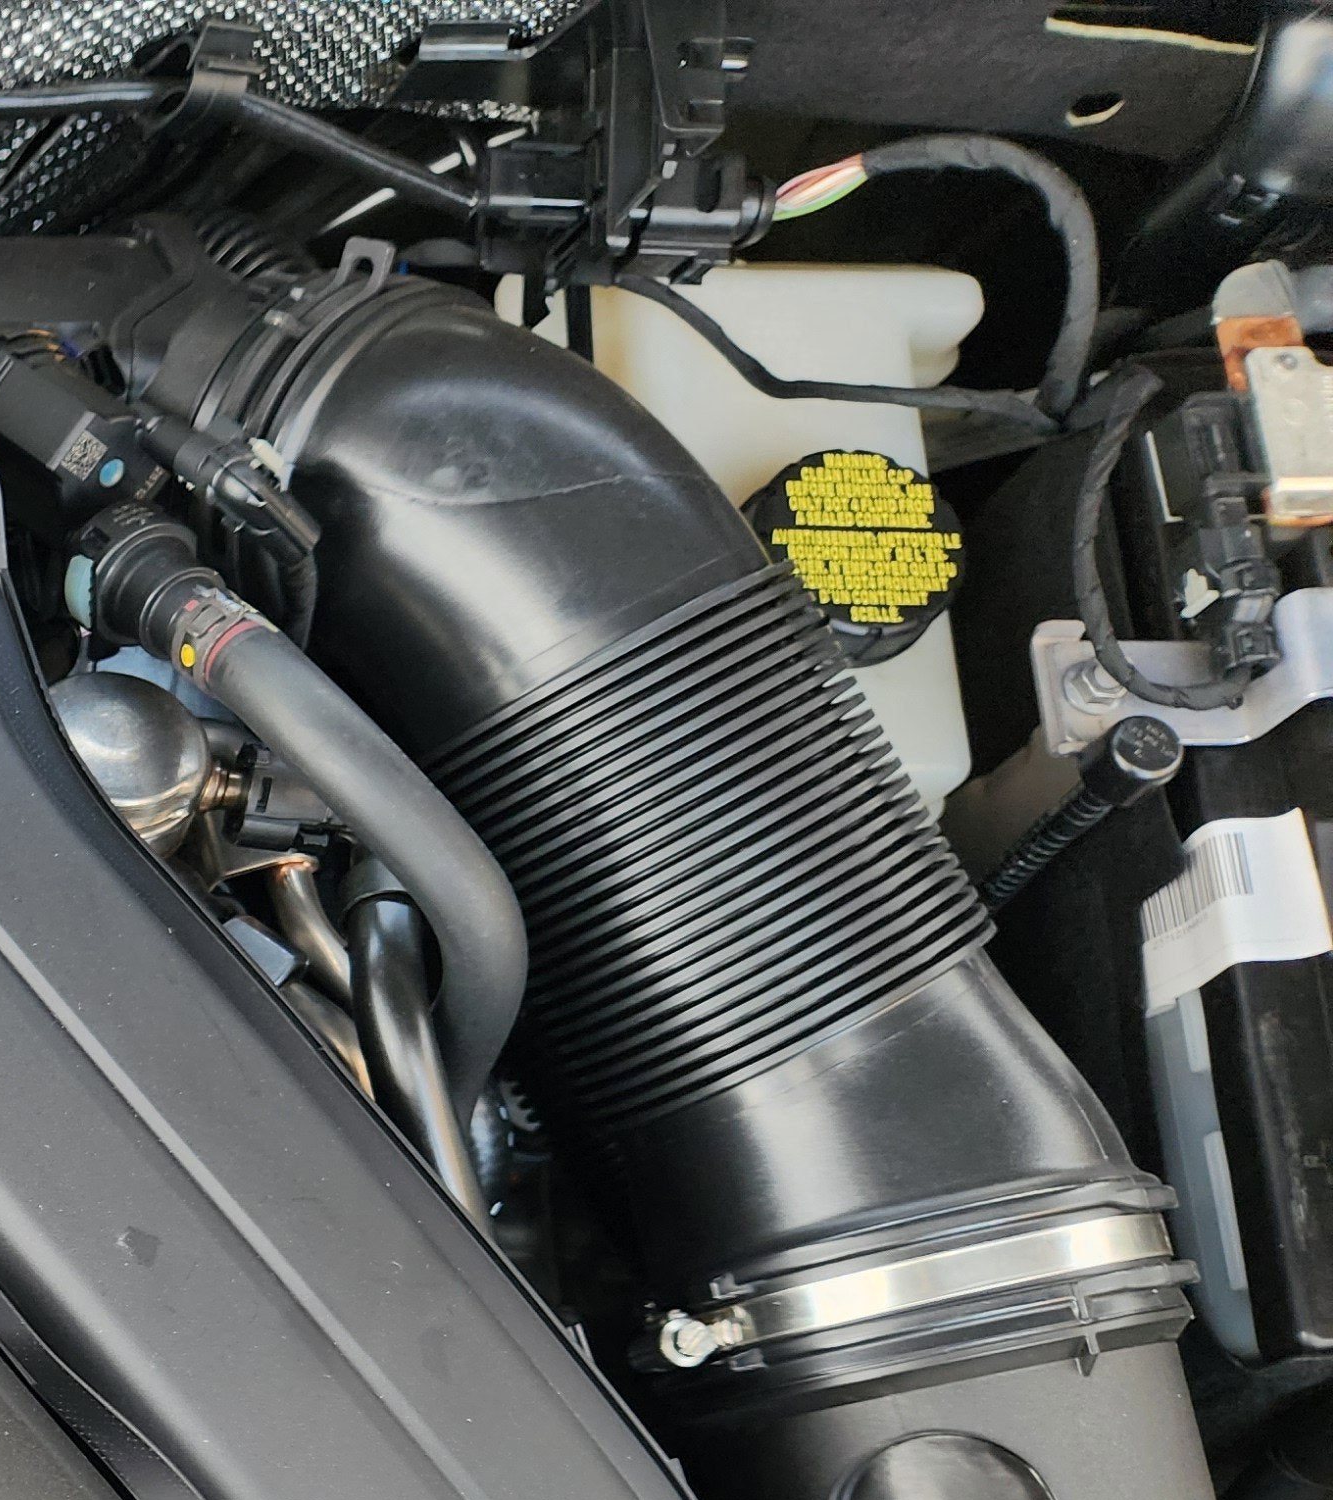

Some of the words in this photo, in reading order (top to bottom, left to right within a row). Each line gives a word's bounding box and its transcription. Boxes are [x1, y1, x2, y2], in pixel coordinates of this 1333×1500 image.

[887, 469, 914, 484] CAP
[789, 497, 821, 511] ONLY
[824, 498, 848, 512] DOT
[861, 499, 898, 513] FLUID
[899, 499, 934, 514] FROM
